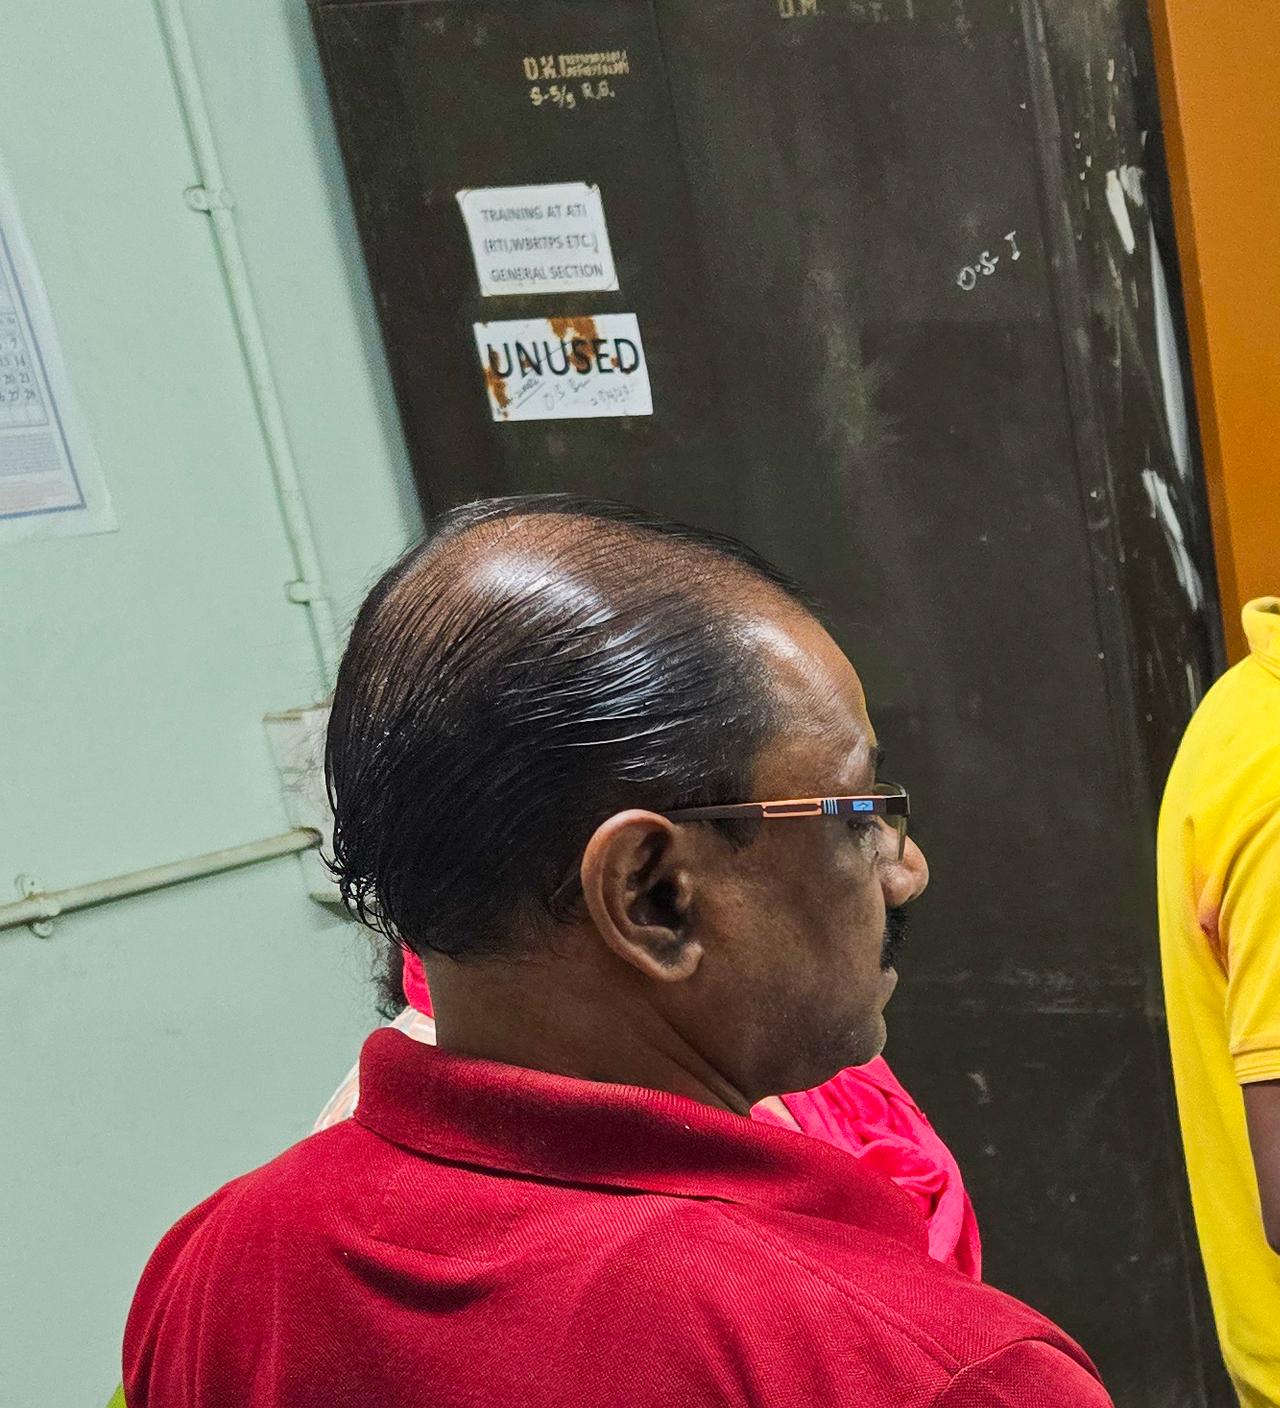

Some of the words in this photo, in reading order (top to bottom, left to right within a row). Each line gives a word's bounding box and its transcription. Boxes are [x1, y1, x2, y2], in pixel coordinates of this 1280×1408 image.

[480, 205, 543, 221] TRAINING
[547, 206, 561, 218] AT
[490, 266, 545, 282] GENERAL
[549, 263, 603, 280] SECTION
[486, 337, 640, 378] UNUSED
